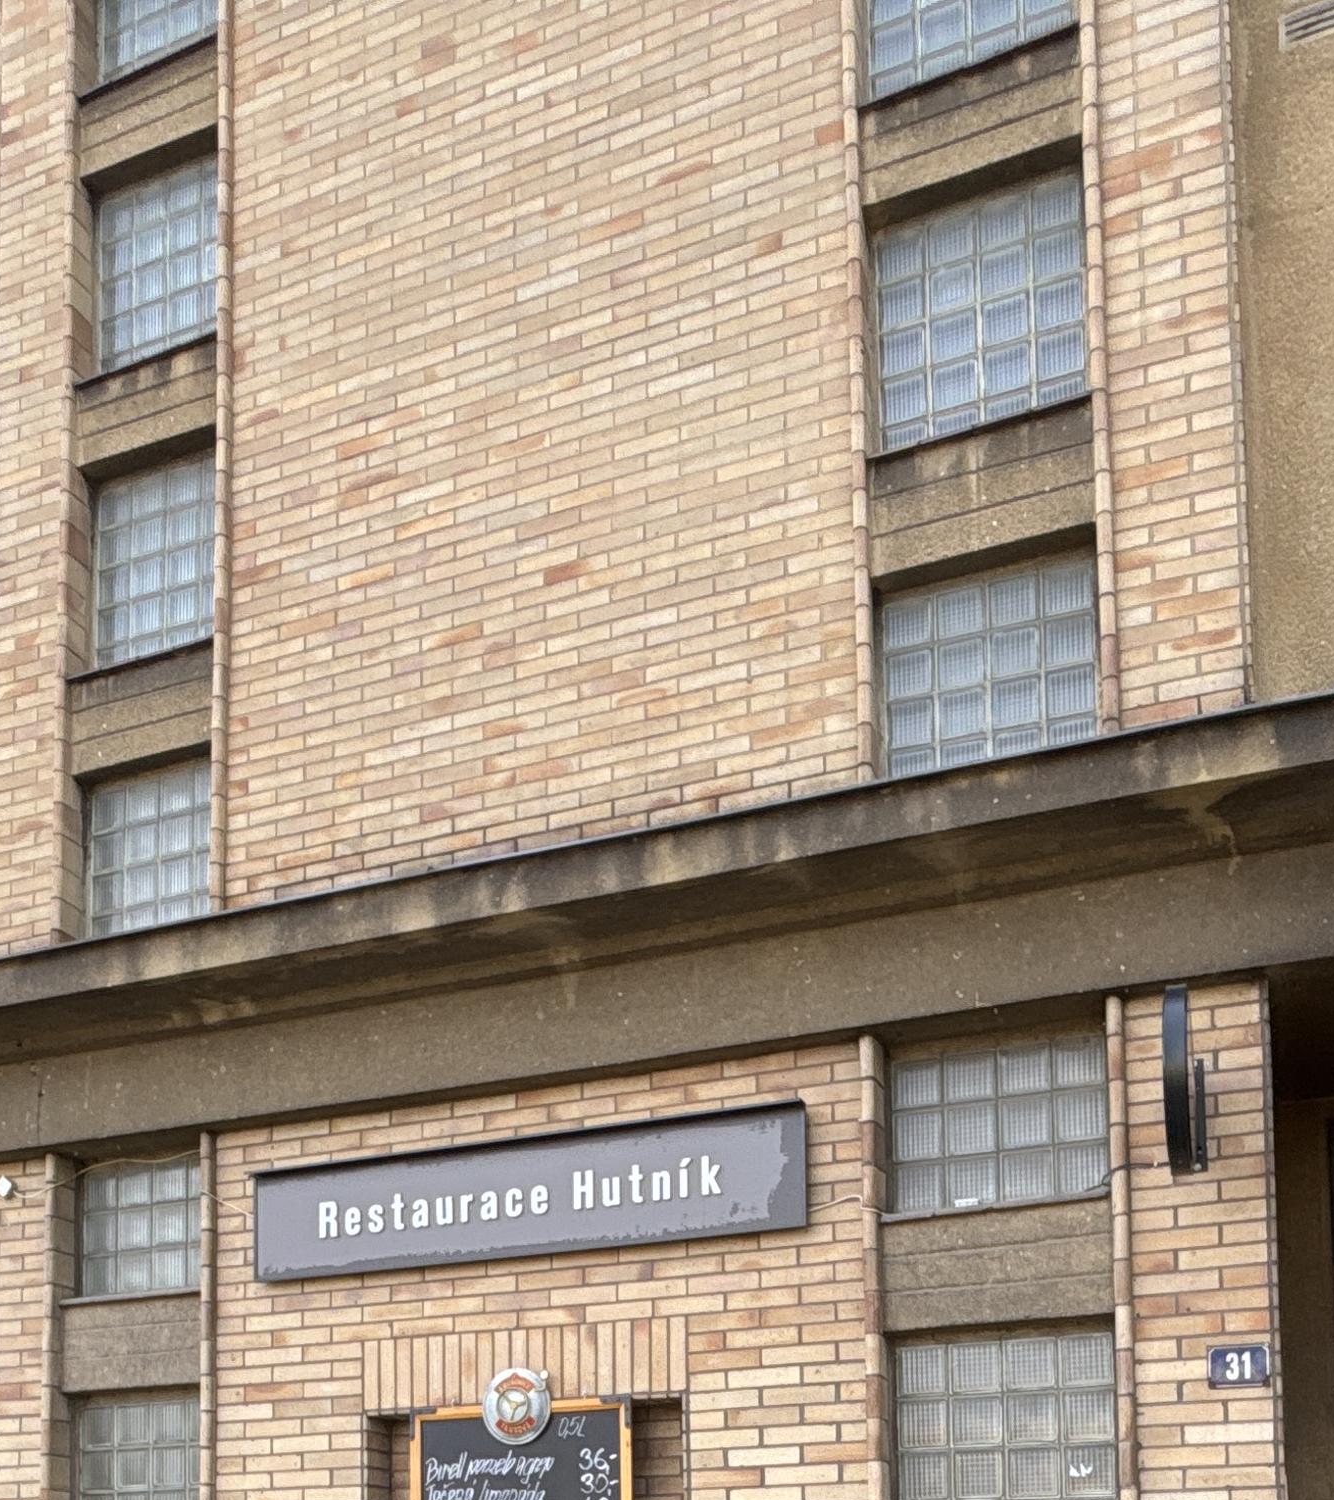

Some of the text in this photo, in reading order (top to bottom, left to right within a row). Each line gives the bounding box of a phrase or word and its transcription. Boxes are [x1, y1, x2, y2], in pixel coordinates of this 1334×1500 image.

[318, 1154, 723, 1239] Restaurace Hutník
[1225, 1350, 1252, 1381] 31
